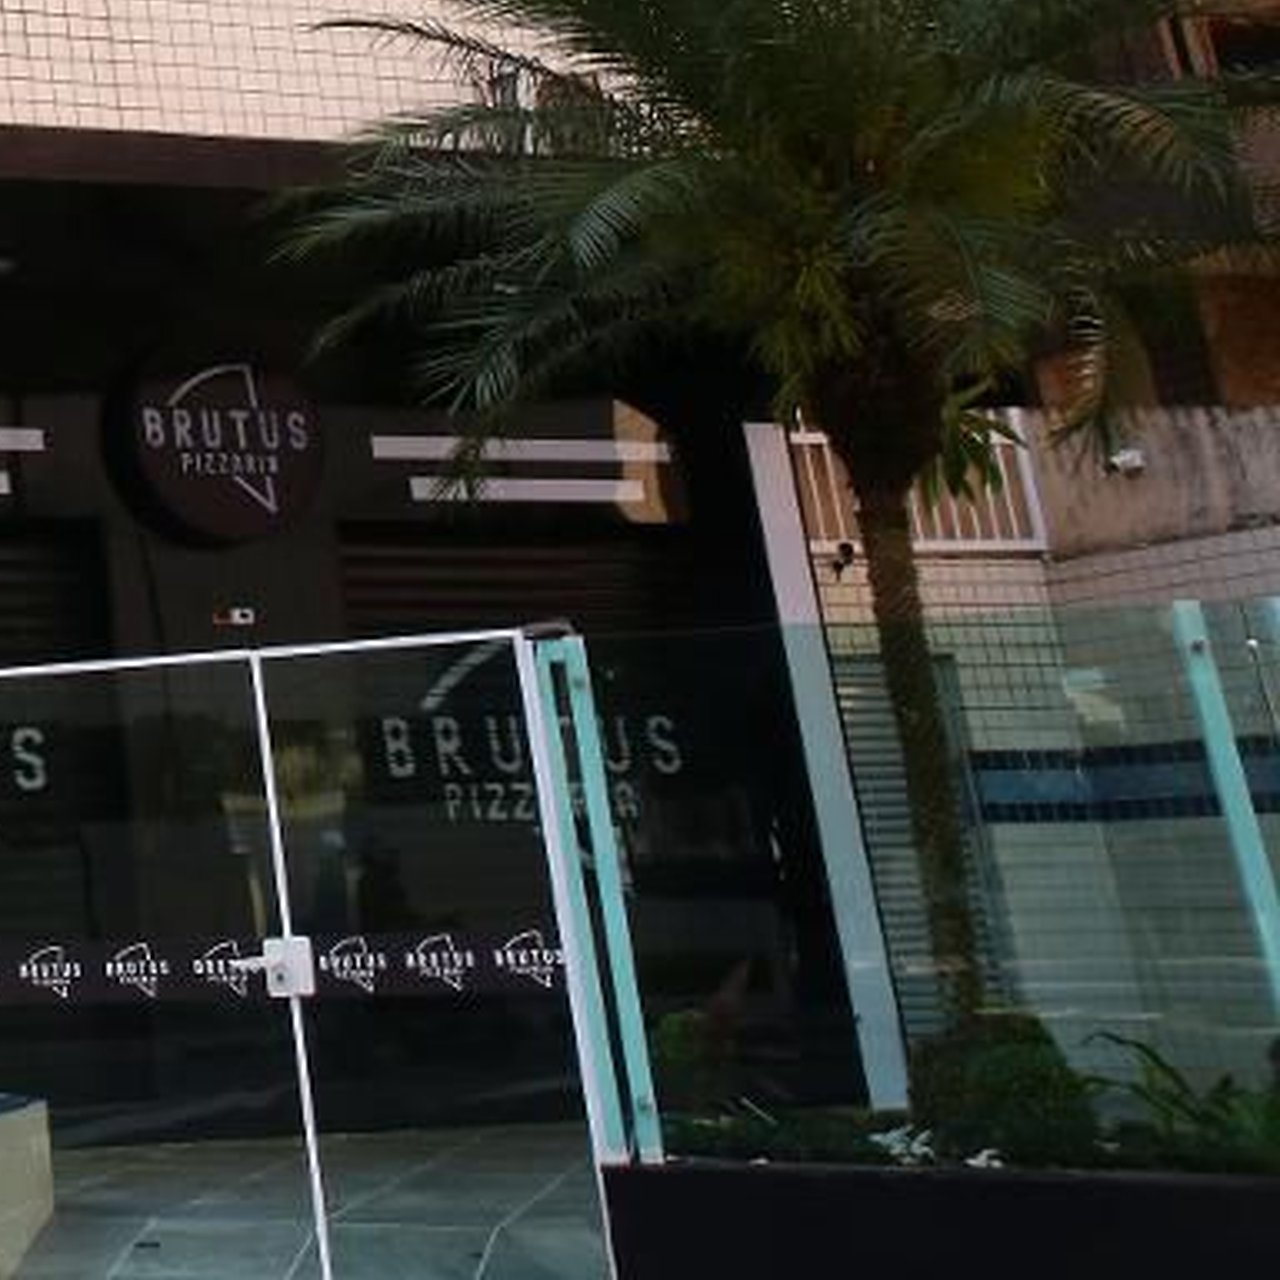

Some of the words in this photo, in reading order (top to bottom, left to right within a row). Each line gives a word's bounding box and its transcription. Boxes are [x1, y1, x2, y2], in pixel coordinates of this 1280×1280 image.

[142, 407, 308, 450] BRUTUS
[180, 452, 279, 475] PIZZARIA
[381, 716, 683, 778] BRUUS
[443, 781, 639, 822] PIZZA
